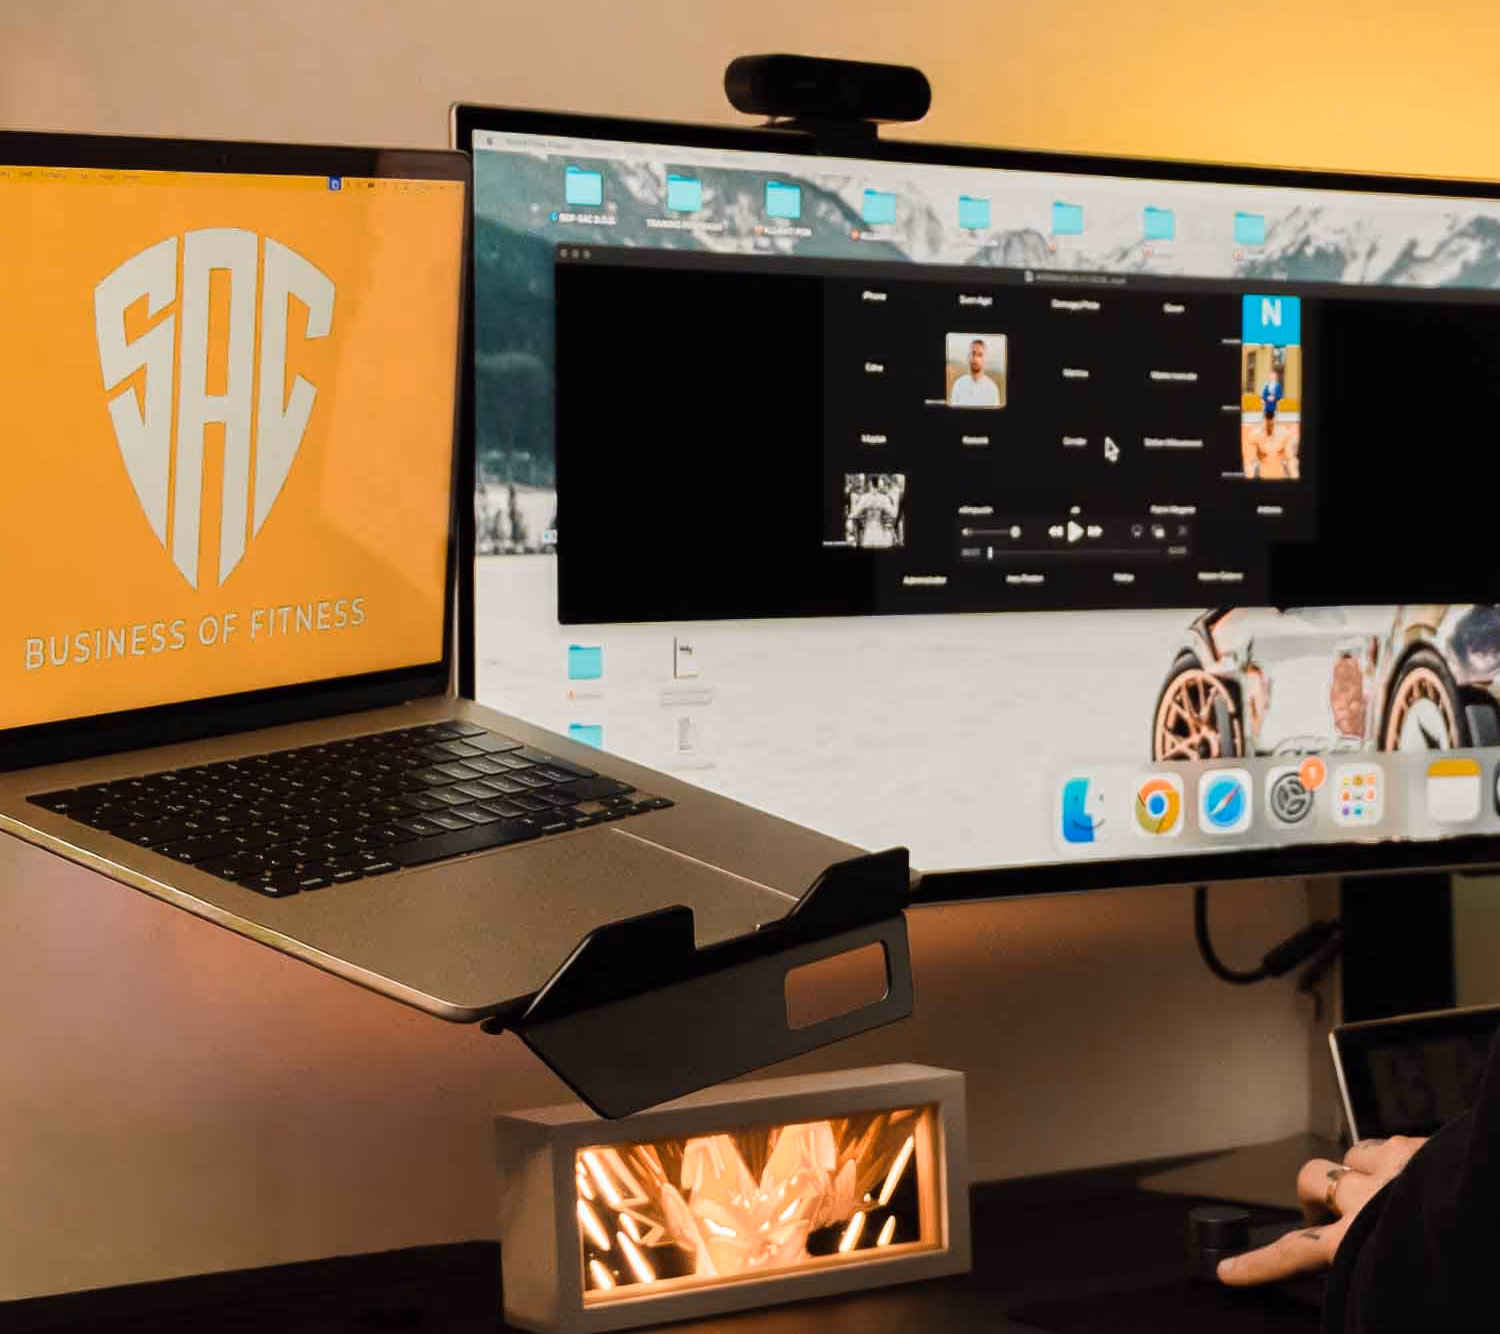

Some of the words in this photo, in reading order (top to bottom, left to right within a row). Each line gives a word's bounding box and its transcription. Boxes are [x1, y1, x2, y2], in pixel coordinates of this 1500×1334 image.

[1261, 298, 1283, 327] N
[93, 227, 337, 593] SAC
[24, 618, 187, 671] BUSINESS
[197, 612, 240, 647] OF
[249, 596, 368, 640] FITNESS
